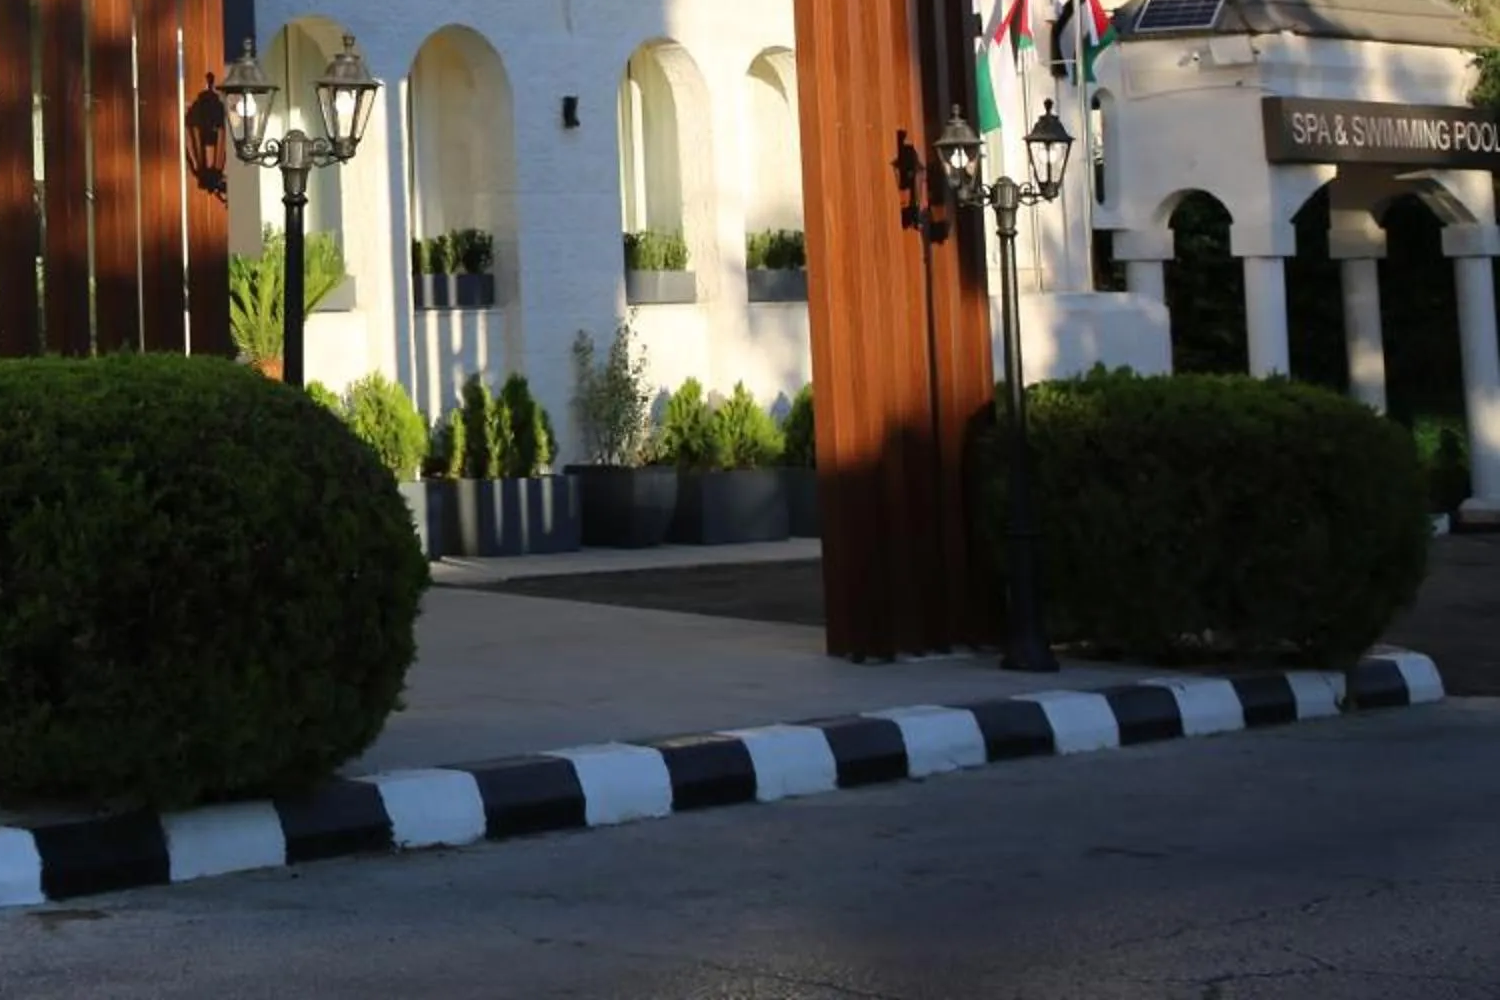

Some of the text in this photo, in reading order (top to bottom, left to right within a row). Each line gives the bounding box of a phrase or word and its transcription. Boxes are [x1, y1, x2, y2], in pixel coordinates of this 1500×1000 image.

[1292, 112, 1500, 153] SPA & SWIMMING POOL
